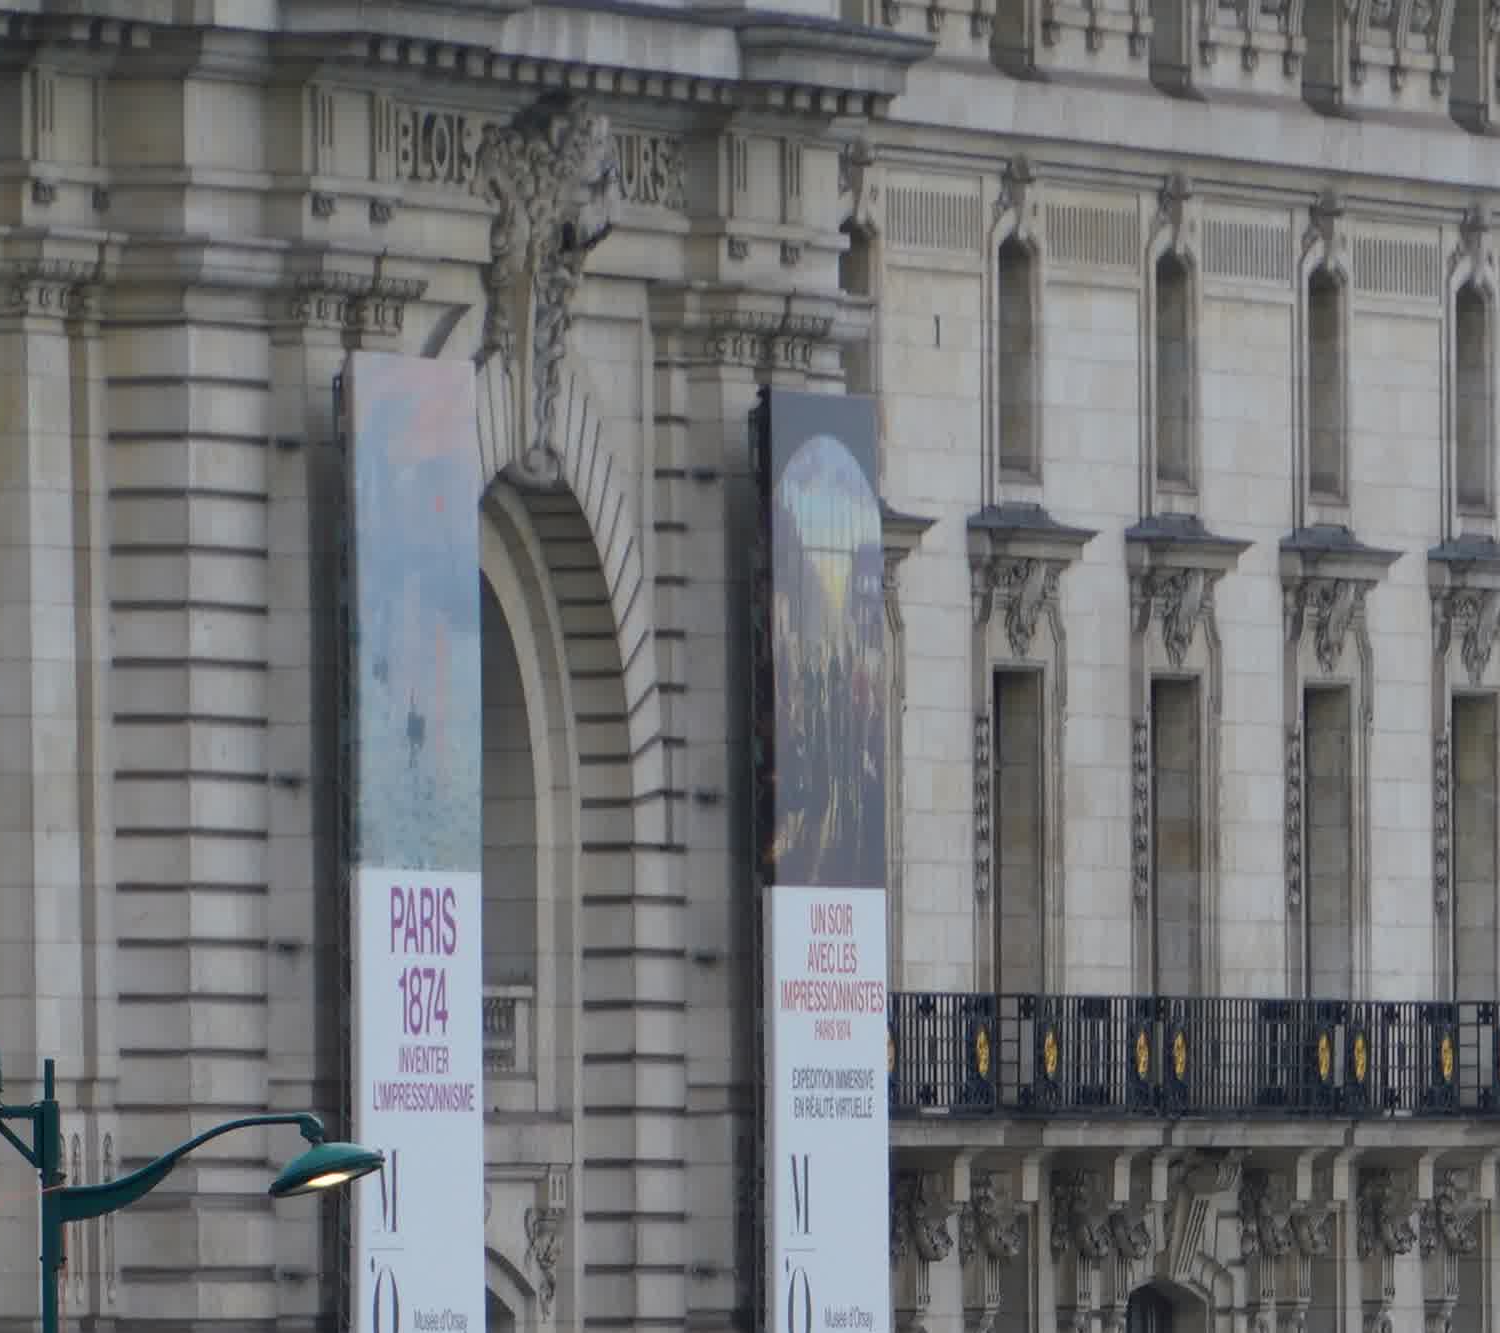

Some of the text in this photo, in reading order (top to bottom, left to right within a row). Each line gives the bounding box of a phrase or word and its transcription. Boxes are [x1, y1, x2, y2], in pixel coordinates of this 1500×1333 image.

[390, 885, 457, 956] PARIS
[810, 903, 853, 937] UN SOIR
[808, 942, 857, 975] AVEC LES
[398, 964, 450, 1036] 1874
[780, 979, 885, 1013] IMPRESSIONNISTES
[399, 1045, 450, 1074] INVENTER
[373, 1079, 476, 1112] L'IMPRESSIONNISME
